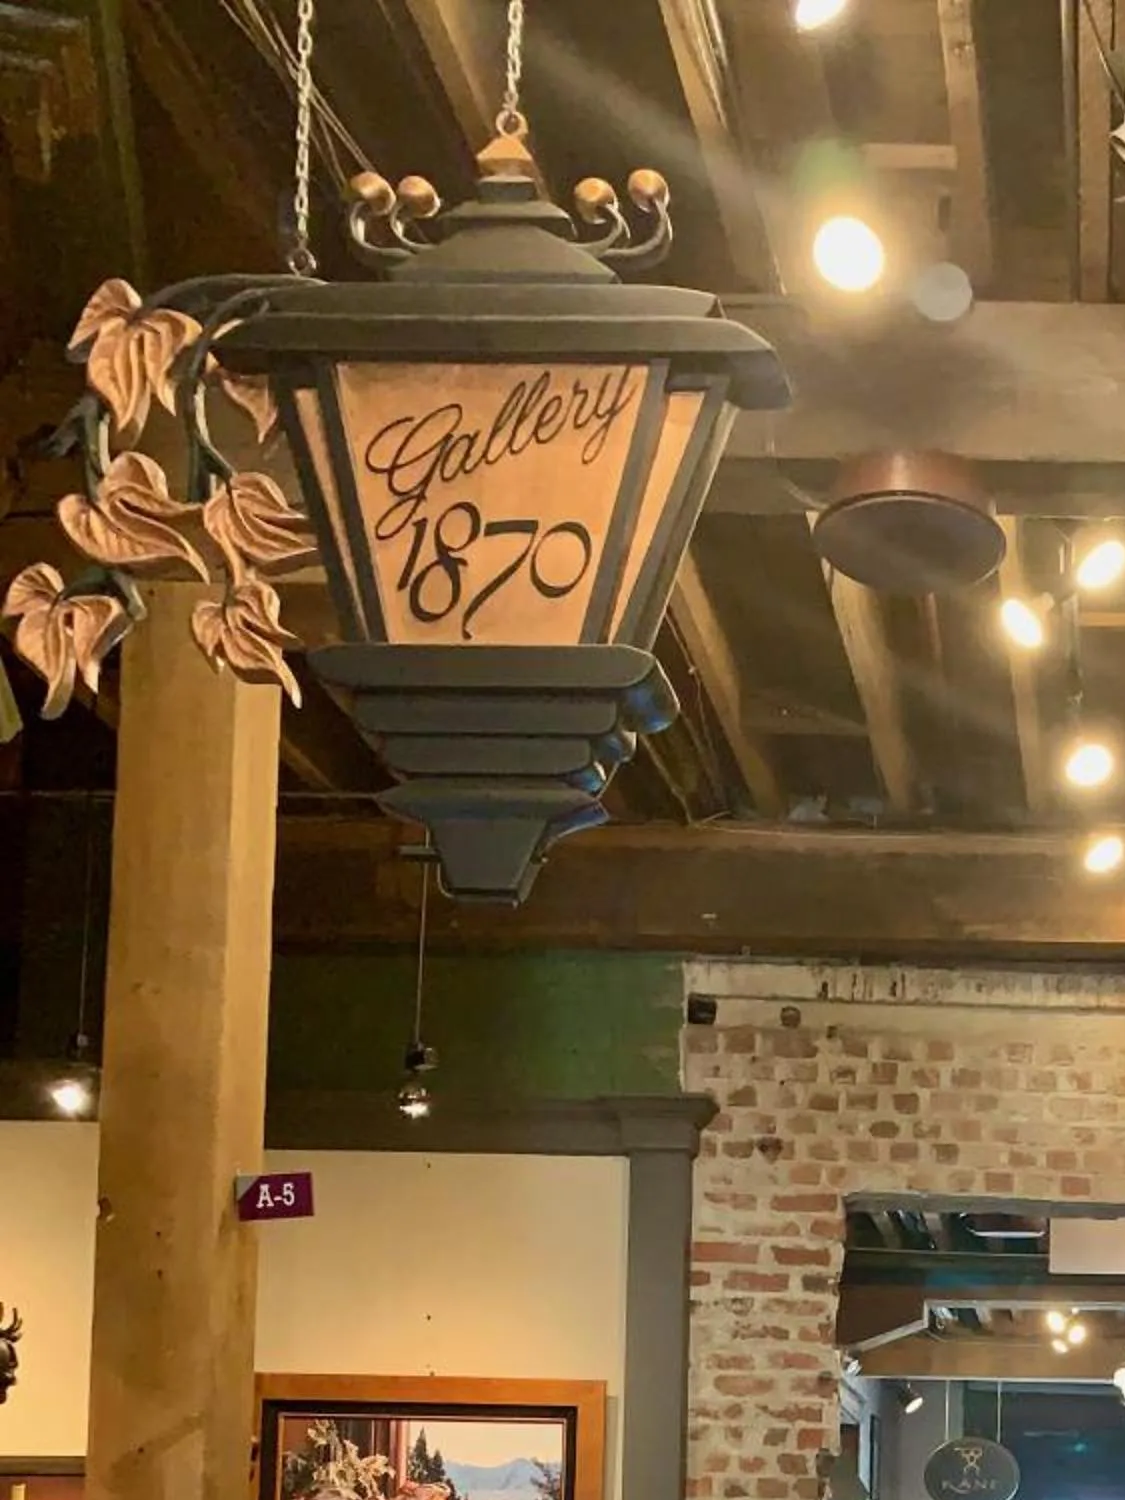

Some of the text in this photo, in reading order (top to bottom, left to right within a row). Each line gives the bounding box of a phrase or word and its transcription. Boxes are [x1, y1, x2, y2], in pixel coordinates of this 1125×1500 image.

[365, 367, 638, 541] Gallery
[397, 500, 592, 640] 1870
[256, 1182, 295, 1208] A-5
